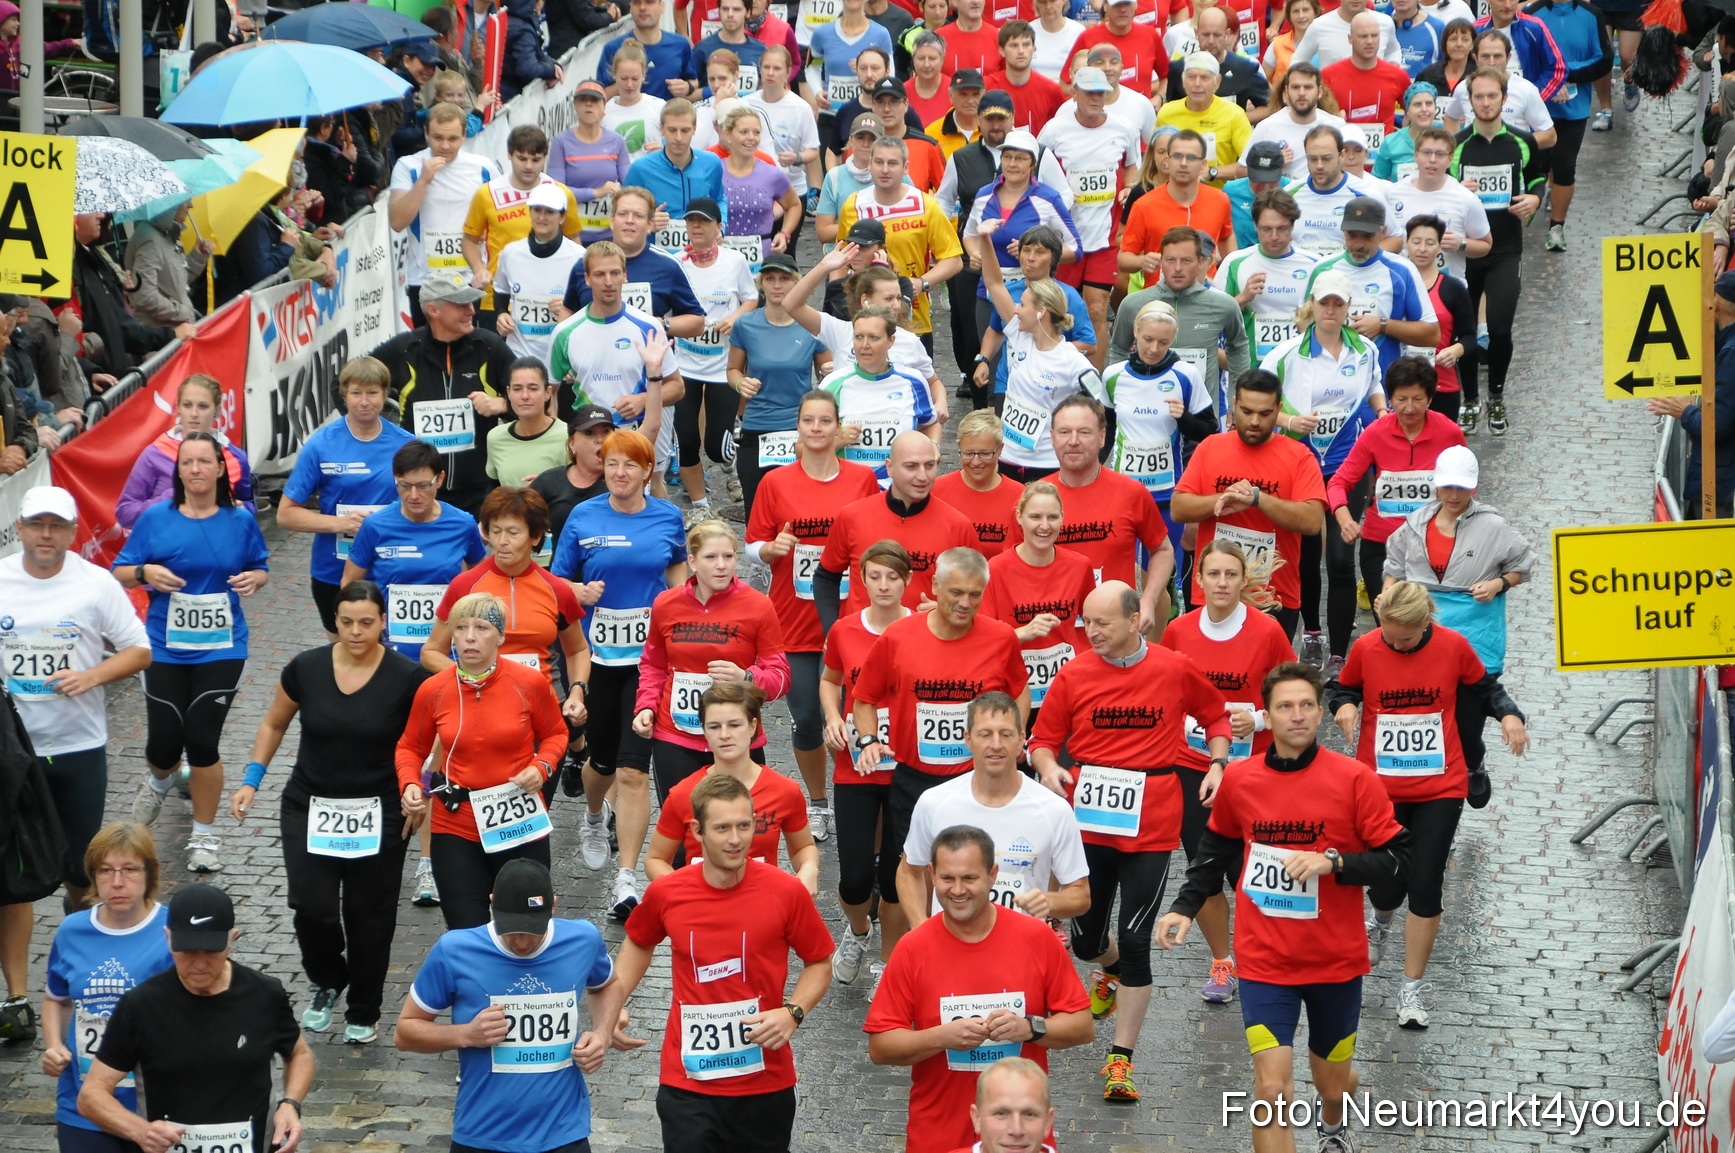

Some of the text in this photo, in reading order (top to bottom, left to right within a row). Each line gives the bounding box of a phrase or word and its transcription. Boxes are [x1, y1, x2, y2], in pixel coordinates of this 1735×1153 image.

[1080, 174, 1108, 192] 359
[1471, 176, 1508, 192] 636
[584, 200, 608, 216] 174
[0, 182, 48, 260] A
[497, 208, 526, 222] MAX
[892, 218, 927, 233] BÖGL
[1304, 220, 1338, 228] Mathias
[434, 237, 463, 255] 483
[1616, 240, 1701, 272] Block
[1267, 285, 1296, 294] Stefan
[1627, 284, 1690, 362] A
[1260, 324, 1300, 343] 2813
[592, 373, 622, 382] Willem
[1324, 388, 1344, 398] Anja
[1132, 406, 1158, 416] Anke
[422, 412, 467, 434] 2971
[1004, 404, 1040, 436] 2200
[433, 437, 458, 446] Hubert
[1004, 428, 1022, 444] Erwina
[1125, 452, 1168, 474] 2795
[1138, 477, 1156, 486] Anke
[1382, 484, 1430, 500] 2139
[810, 527, 824, 535] FOR
[1069, 532, 1082, 541] FOR
[1216, 527, 1265, 544] PARTL Neumarkt
[1568, 568, 1734, 596] Schnuppe
[396, 600, 434, 620] 303
[1636, 602, 1696, 630] lauf
[174, 608, 226, 629] 3055
[594, 612, 642, 622] PARTL Neumarkt
[1018, 614, 1032, 622] RUN
[406, 626, 432, 635] Christ
[595, 622, 647, 644] 3118
[672, 632, 687, 640] RUN
[688, 632, 702, 640] FOR
[1038, 650, 1064, 661] Neumarkt
[12, 654, 70, 676] 2134
[674, 678, 692, 686] PARTL
[918, 690, 932, 698] RUN
[934, 690, 948, 698] FOR
[918, 708, 940, 716] PARTL
[1094, 718, 1112, 726] RUN
[1113, 716, 1128, 726] FOR
[923, 718, 965, 741] 265
[1382, 728, 1437, 752] 2092
[940, 746, 964, 756] Erich
[1392, 758, 1428, 768] Ramona
[1080, 772, 1132, 784] PARTL Neumarkt
[472, 794, 496, 805] PARTL
[1080, 782, 1136, 810] 3150
[482, 792, 538, 830] 2255
[316, 810, 374, 834] 2264
[499, 824, 534, 840] Daniela
[1270, 832, 1285, 842] FOR
[328, 840, 360, 851] Angela
[1252, 850, 1269, 860] PARTL
[1264, 896, 1293, 908] Armin
[708, 965, 729, 978] DEHN
[523, 1000, 564, 1010] Neumarkt
[942, 1000, 1011, 1012] PARTL Neumarkt
[682, 1008, 746, 1020] PARTL Neumarkt
[505, 1012, 570, 1044] 2084
[85, 1028, 101, 1055] 2
[690, 1021, 752, 1051] 2316
[515, 1050, 556, 1062] Jochen
[698, 1054, 747, 1070] Christian
[970, 1050, 1004, 1061] Stefan
[194, 1132, 237, 1141] Neumarkt
